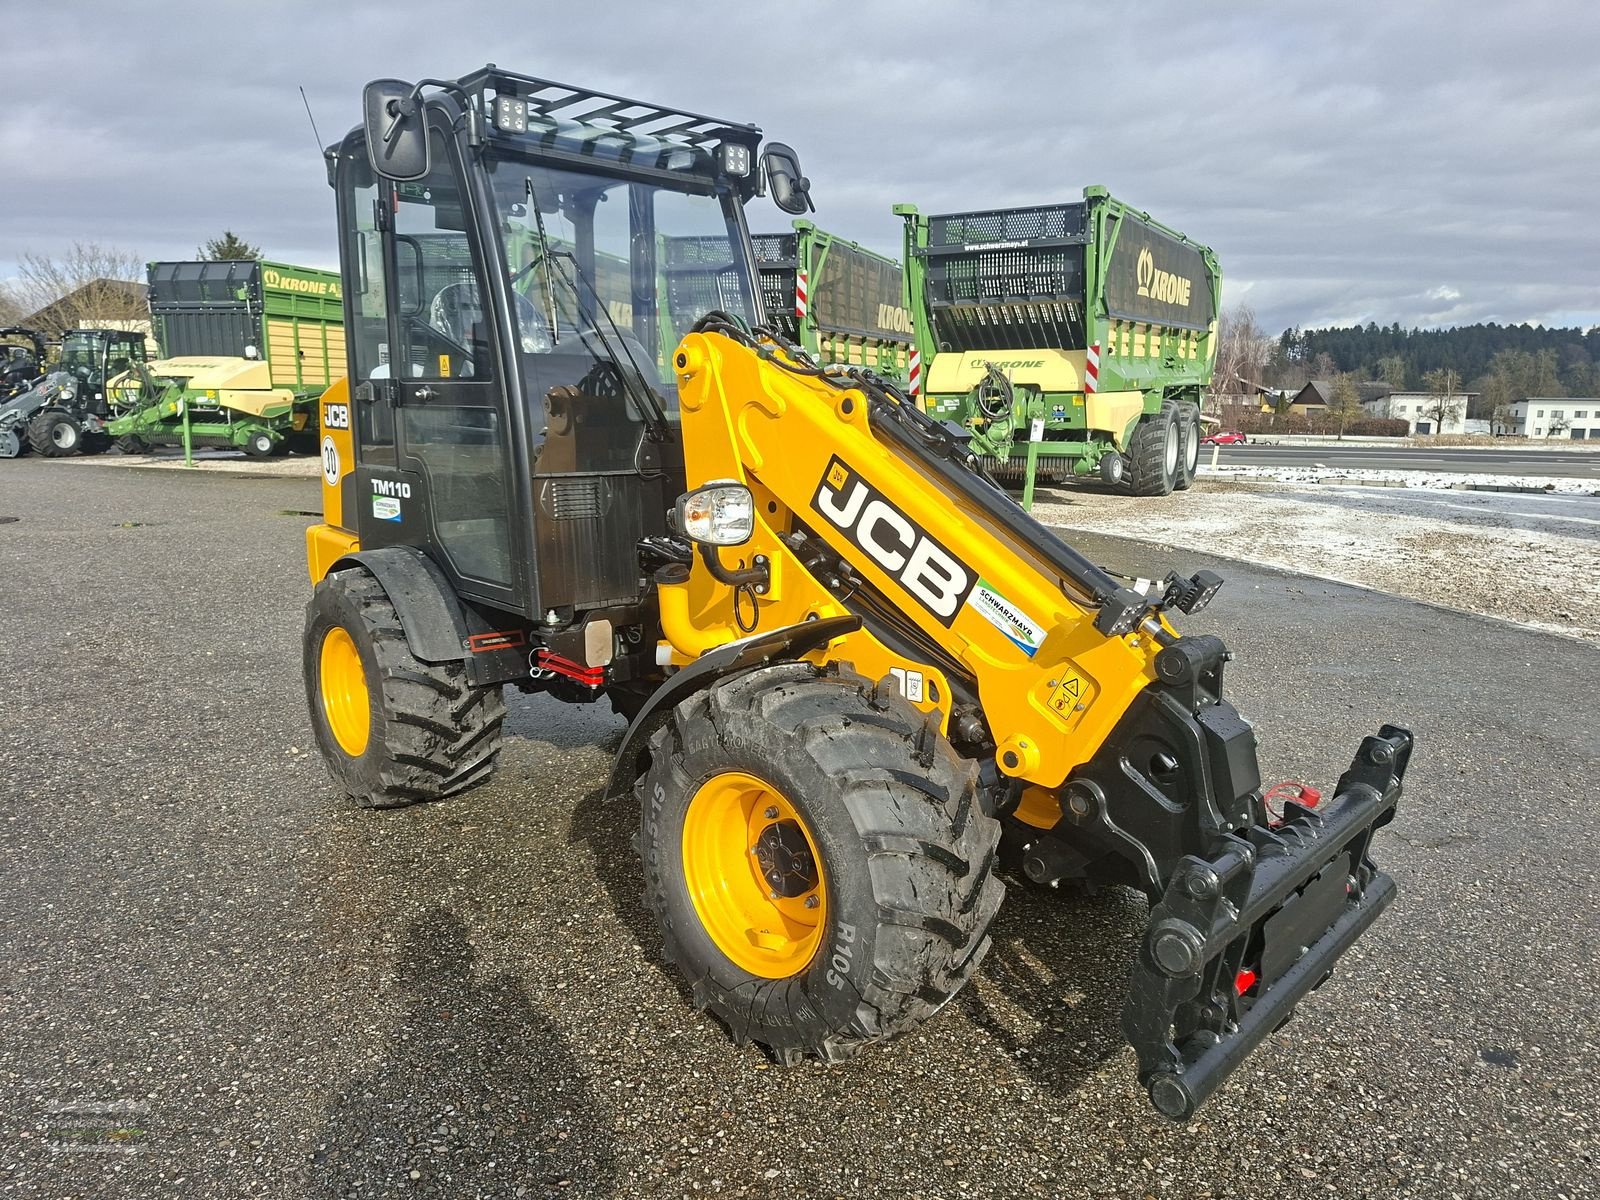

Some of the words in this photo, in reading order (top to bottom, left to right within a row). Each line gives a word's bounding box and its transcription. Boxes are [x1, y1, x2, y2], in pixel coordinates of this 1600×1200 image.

[280, 277, 327, 294] KRONE
[1150, 267, 1192, 307] KRONE
[324, 404, 349, 428] JCB
[324, 445, 337, 476] 30
[370, 478, 411, 499] TM110
[818, 480, 969, 618] JCB
[979, 588, 1034, 637] SCHWARZMAYR
[826, 920, 857, 992] R105
